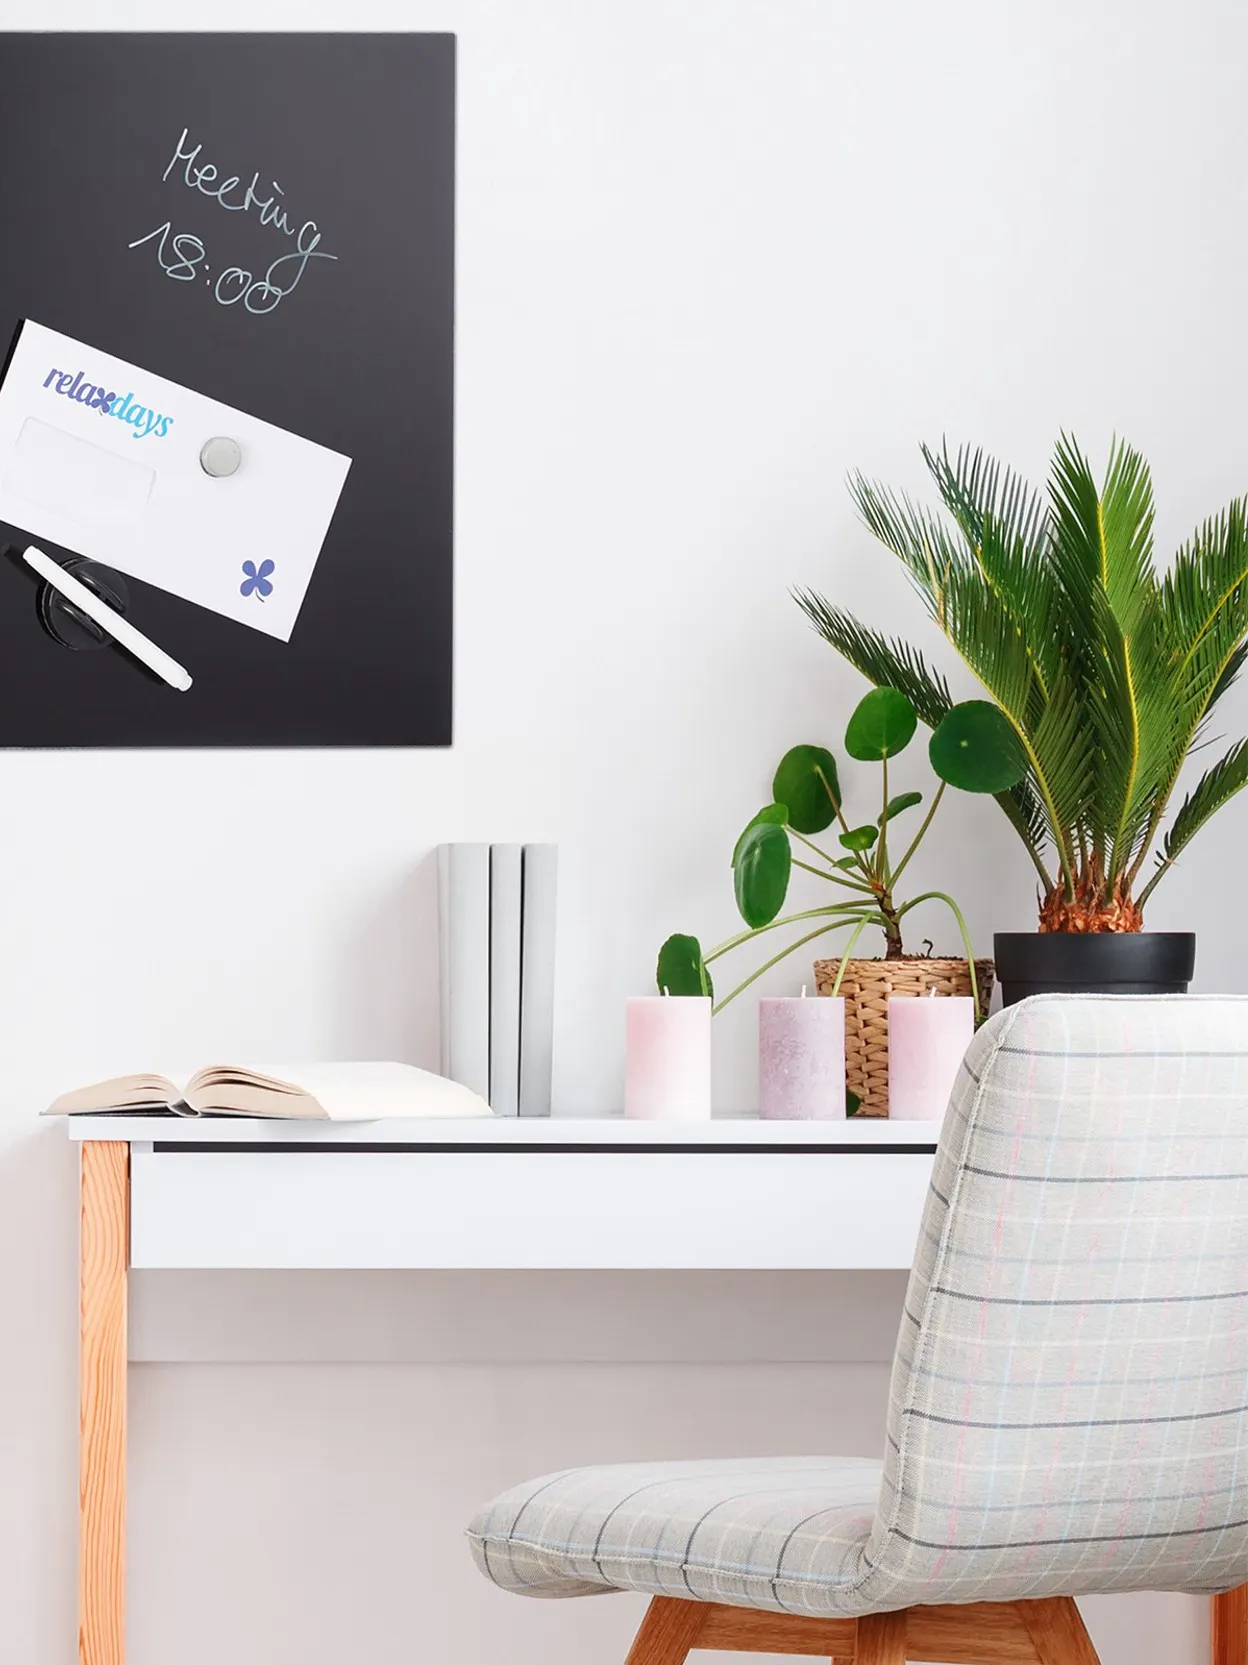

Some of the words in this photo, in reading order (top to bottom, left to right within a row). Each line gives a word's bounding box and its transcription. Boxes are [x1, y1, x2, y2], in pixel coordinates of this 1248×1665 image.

[163, 128, 338, 296] Meeting
[128, 221, 282, 314] 18:00
[42, 367, 174, 439] relaxdays
